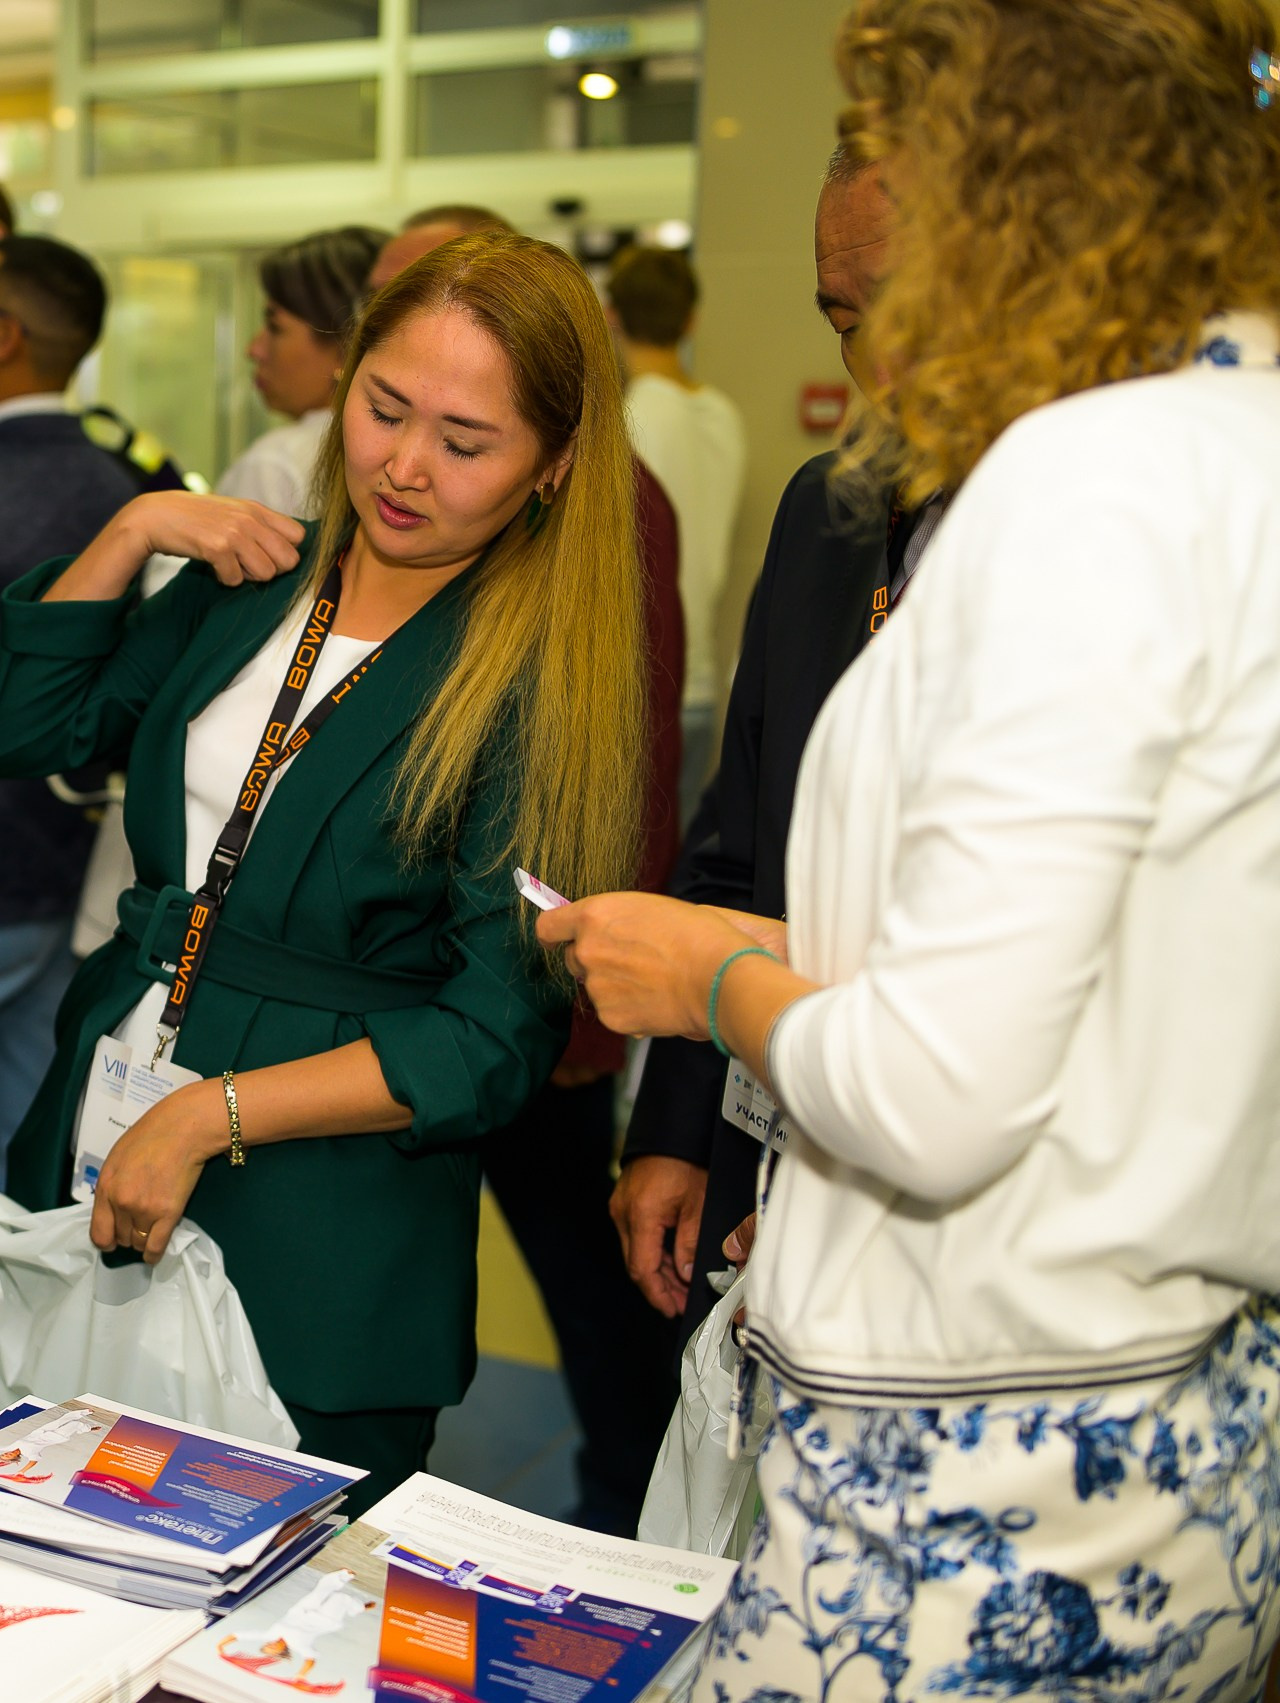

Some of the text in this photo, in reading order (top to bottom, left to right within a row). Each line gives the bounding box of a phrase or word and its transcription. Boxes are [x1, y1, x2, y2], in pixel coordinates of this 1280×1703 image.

[287, 598, 335, 690] BOWA
[869, 586, 888, 634] BO
[240, 721, 287, 812] BOWA
[171, 904, 209, 1006] BOWA
[104, 1054, 128, 1081] VIII
[135, 1511, 224, 1546] Плетакс®
